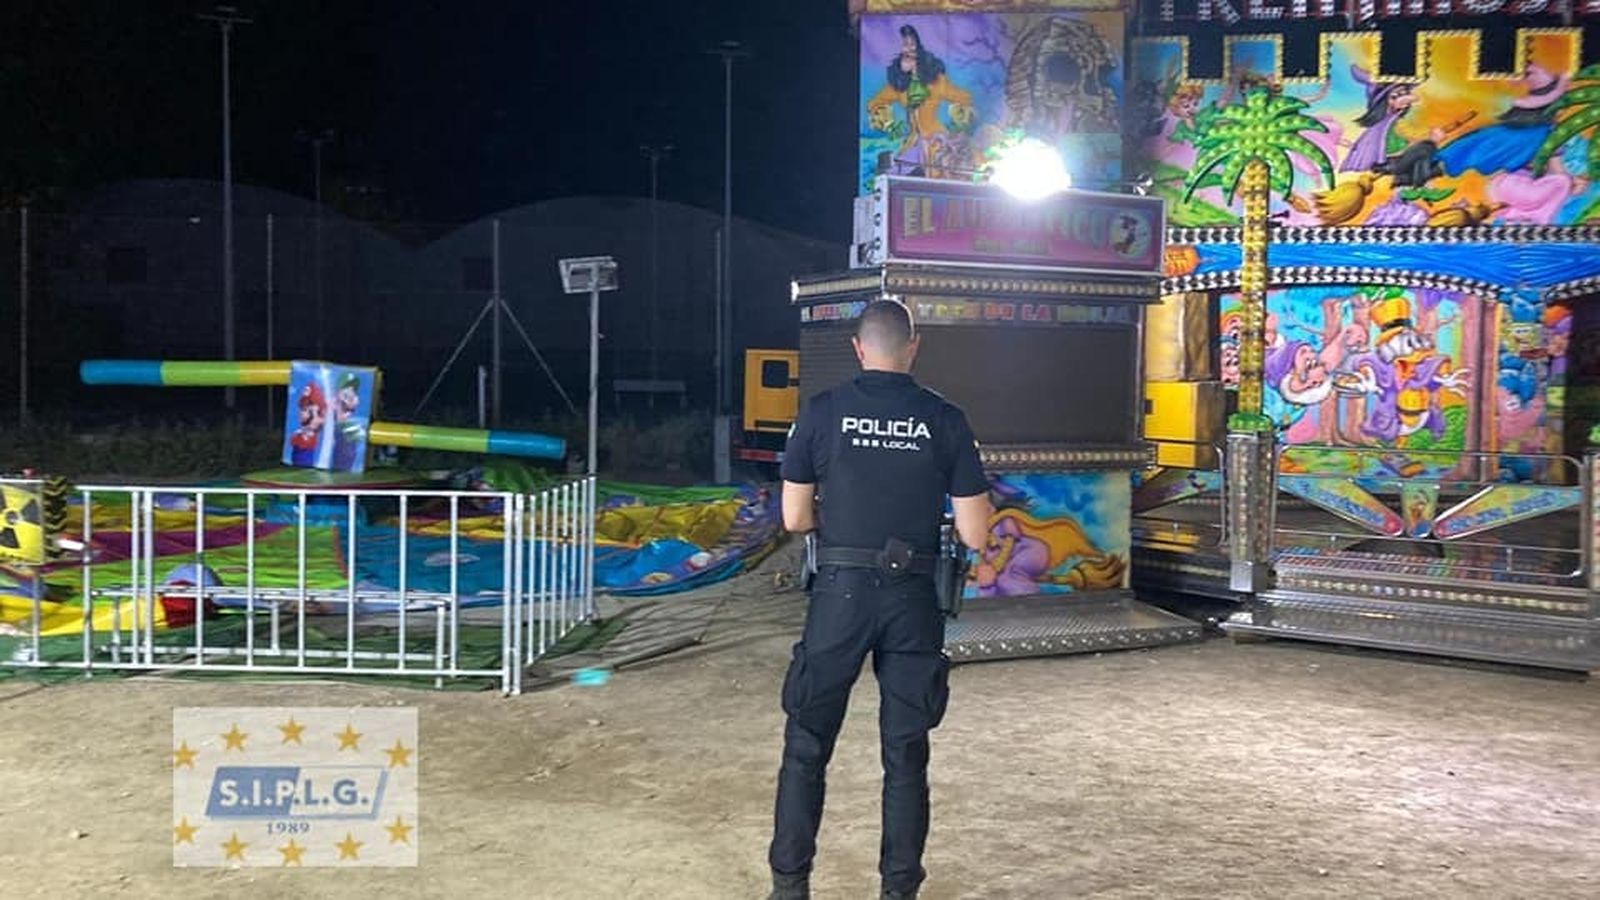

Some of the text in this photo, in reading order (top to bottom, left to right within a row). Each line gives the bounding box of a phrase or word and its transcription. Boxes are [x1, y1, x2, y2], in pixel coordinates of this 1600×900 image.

[904, 197, 935, 239] EL
[841, 417, 931, 439] POLICÍA
[882, 441, 920, 451] LOCAL
